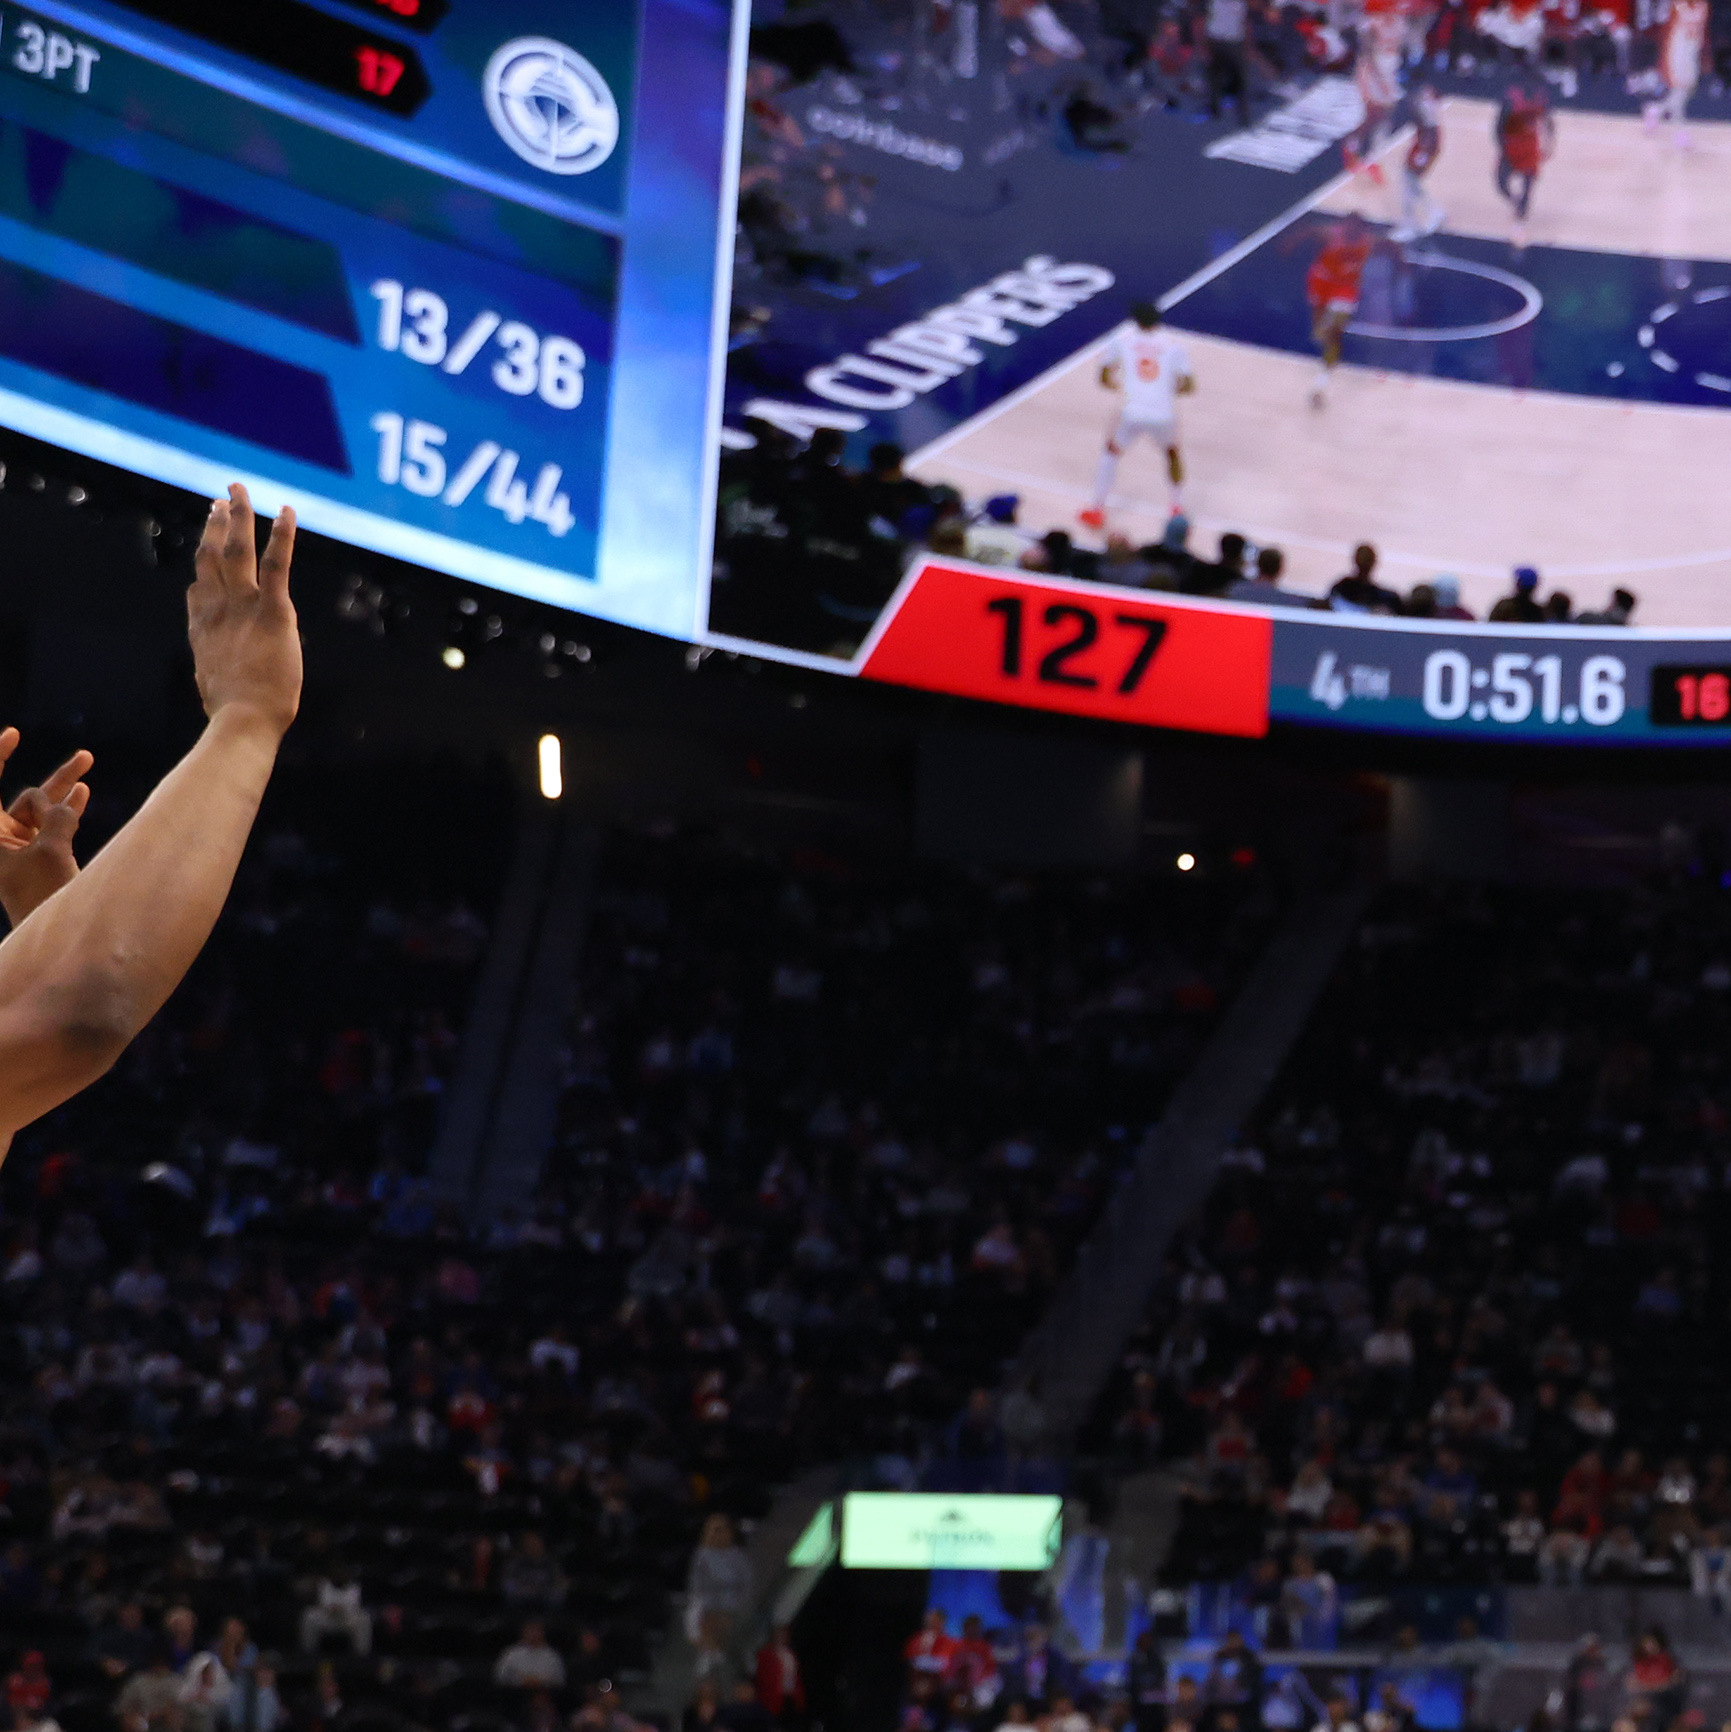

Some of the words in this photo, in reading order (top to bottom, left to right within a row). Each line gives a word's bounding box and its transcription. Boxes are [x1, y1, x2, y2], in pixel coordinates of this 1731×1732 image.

[15, 22, 101, 94] 3PT
[356, 47, 405, 97] 17
[372, 280, 587, 411] 13/36
[803, 254, 1115, 411] CLIPPERS
[371, 411, 576, 537] 15/44
[985, 596, 1169, 694] 127
[1422, 648, 1628, 727] 0:51.6
